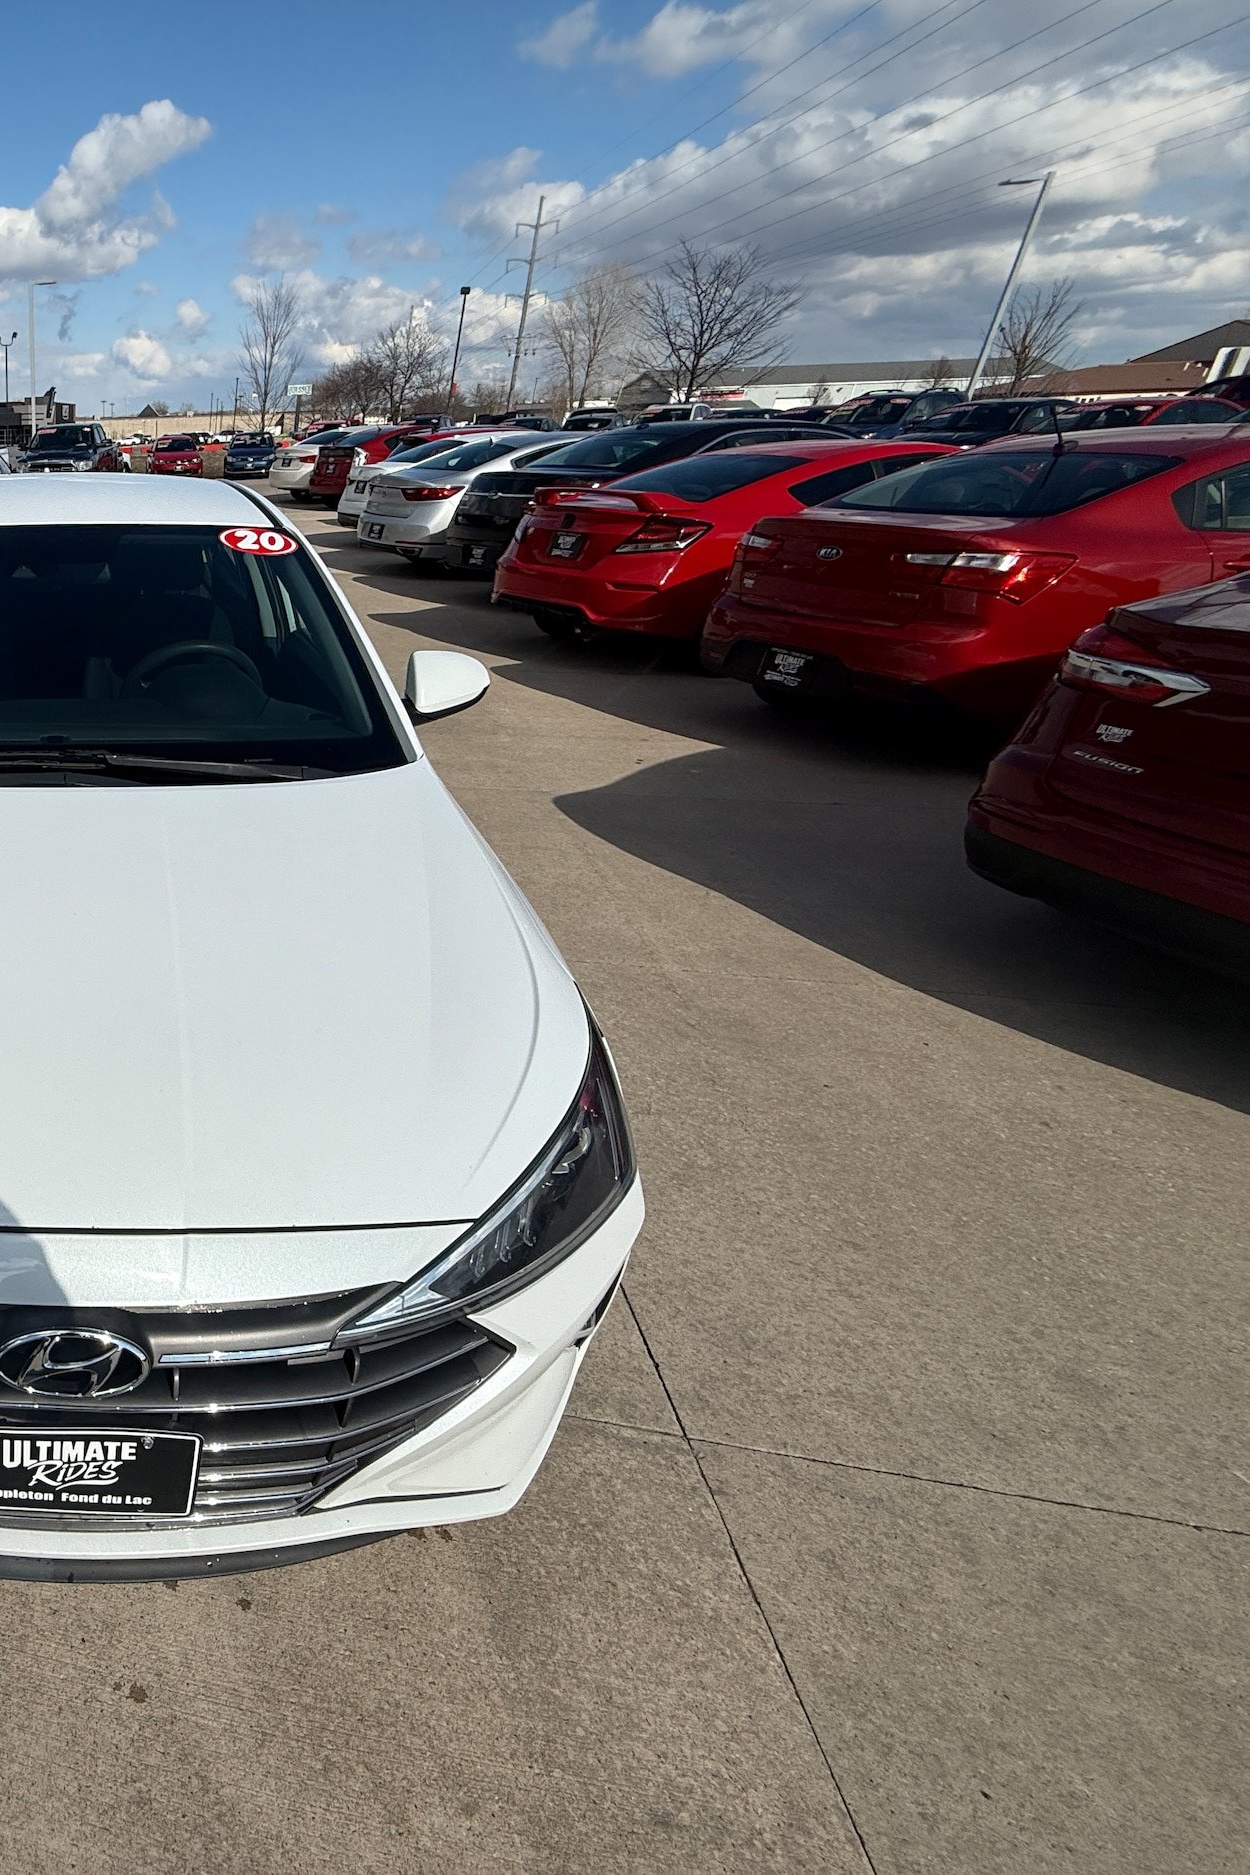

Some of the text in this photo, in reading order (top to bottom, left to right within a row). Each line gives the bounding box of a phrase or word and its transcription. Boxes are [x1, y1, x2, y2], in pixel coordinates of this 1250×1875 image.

[234, 530, 285, 551] 20
[2, 1439, 137, 1468] ULTIMATE
[61, 1492, 99, 1504] Fond
[102, 1493, 122, 1505] du
[125, 1494, 152, 1506] Lac
